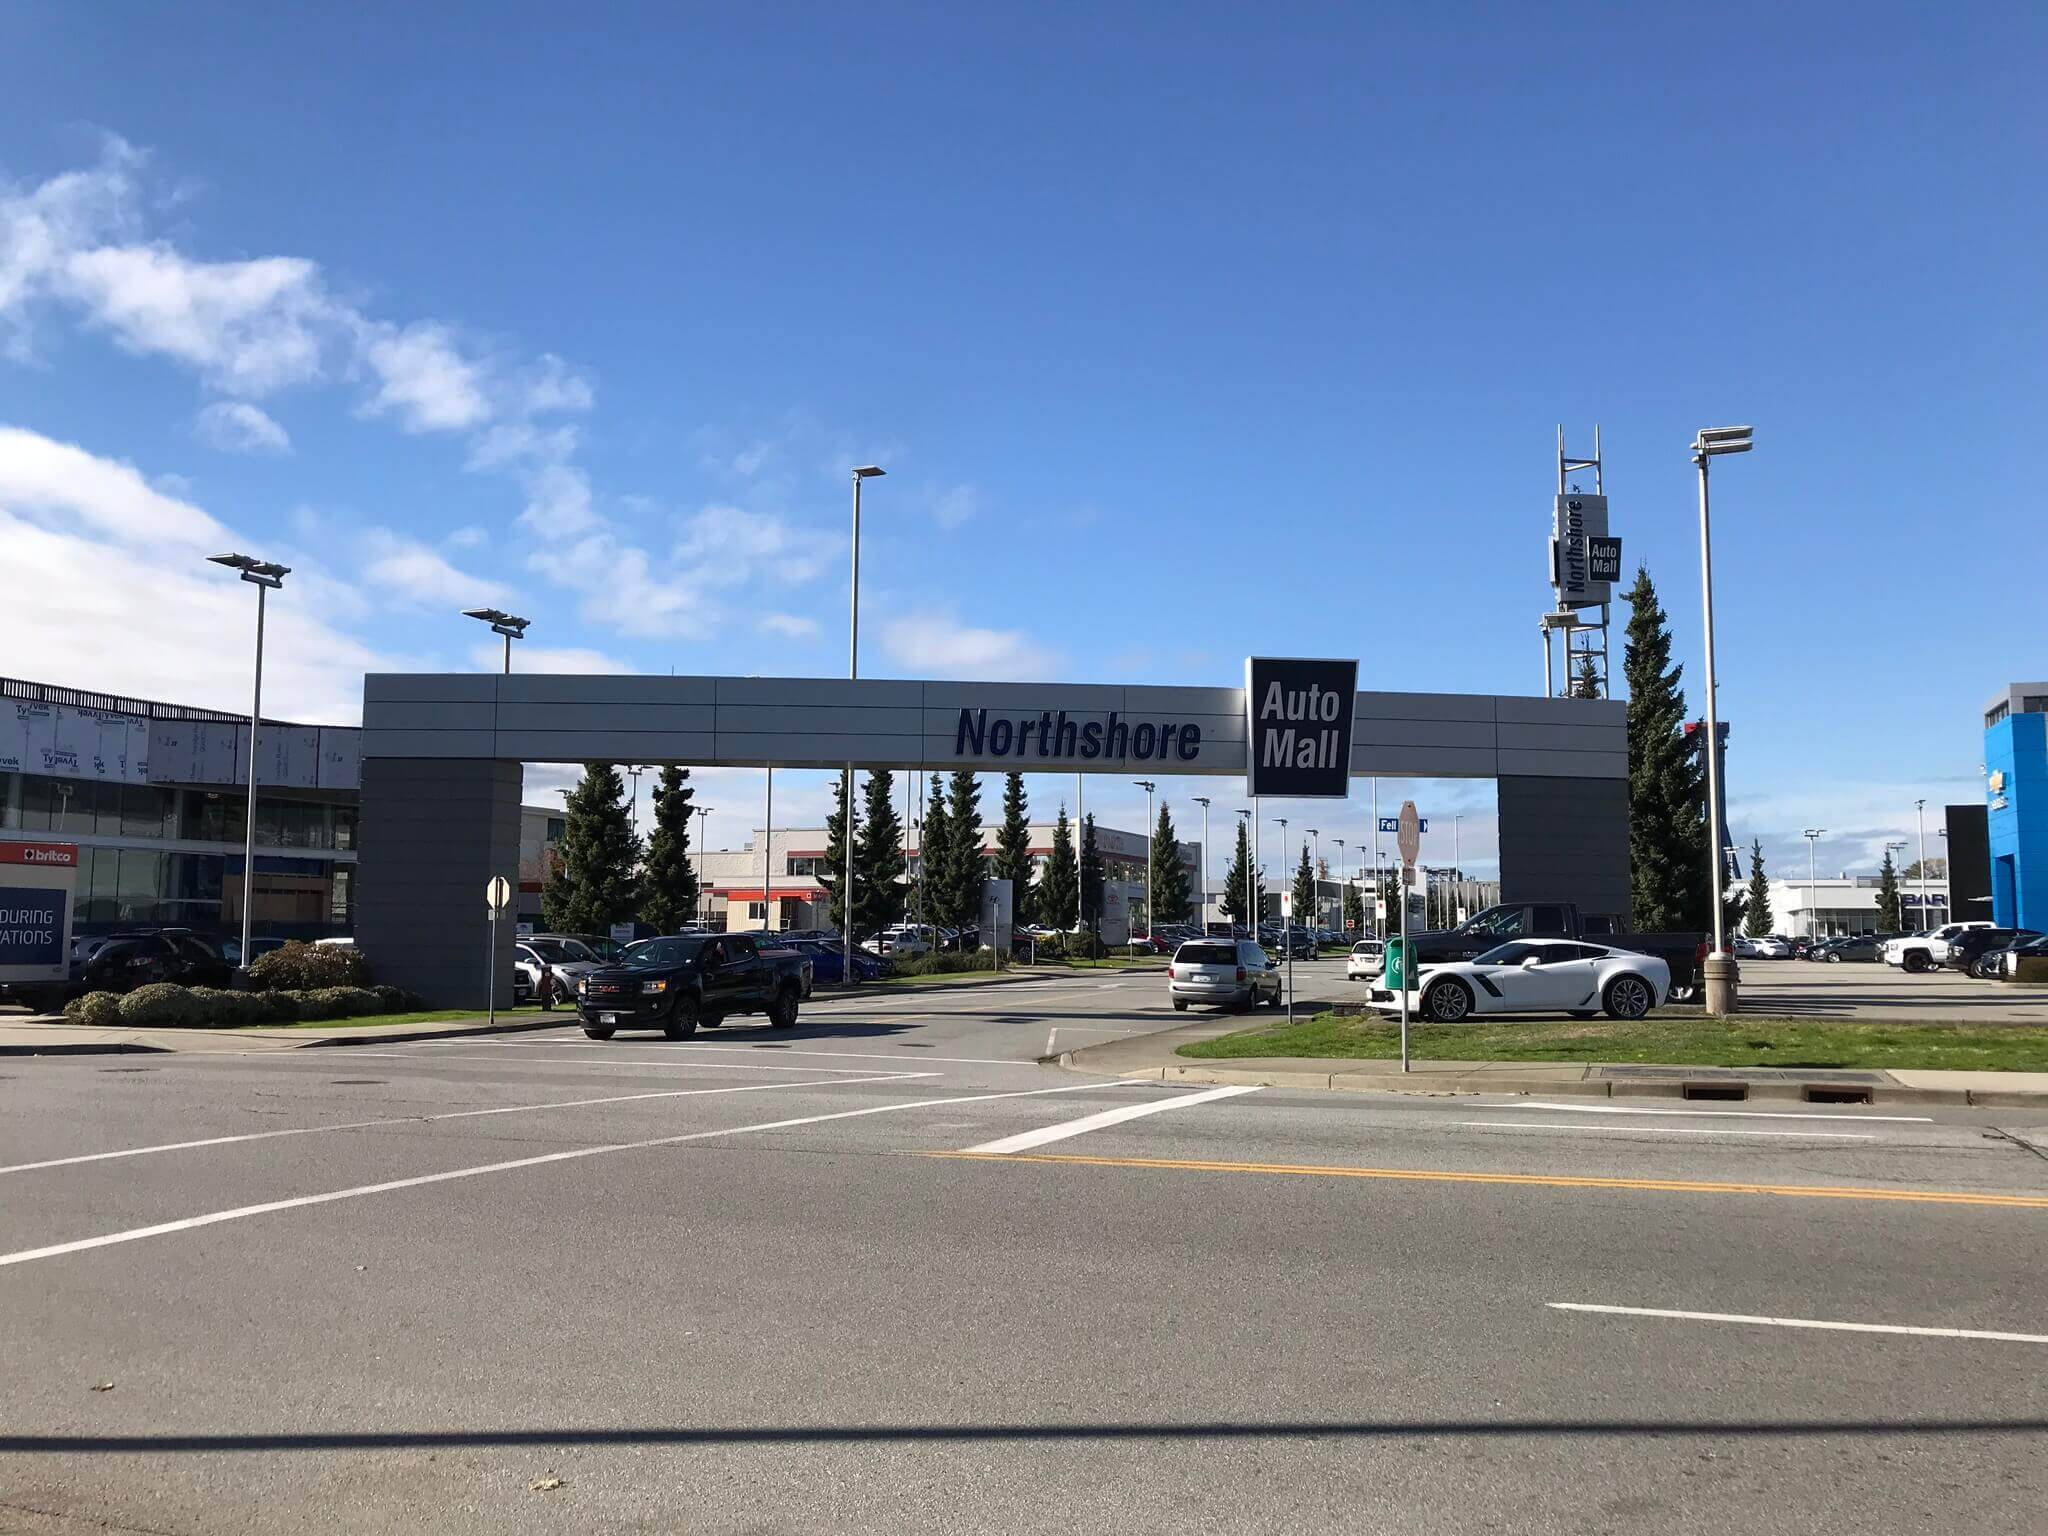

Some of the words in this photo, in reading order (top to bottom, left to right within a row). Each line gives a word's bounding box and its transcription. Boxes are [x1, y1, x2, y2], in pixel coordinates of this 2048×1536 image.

[1565, 500, 1585, 593] Northshore
[1591, 543, 1617, 558] Auto
[1592, 559, 1617, 573] Mall
[1260, 681, 1341, 722] Auto
[955, 708, 1201, 760] Northshore
[1262, 728, 1340, 768] Mall
[0, 756, 19, 766] vek
[1380, 819, 1397, 830] Fell
[1400, 821, 1418, 846] STOP
[36, 849, 71, 862] britco
[0, 909, 53, 924] DURING
